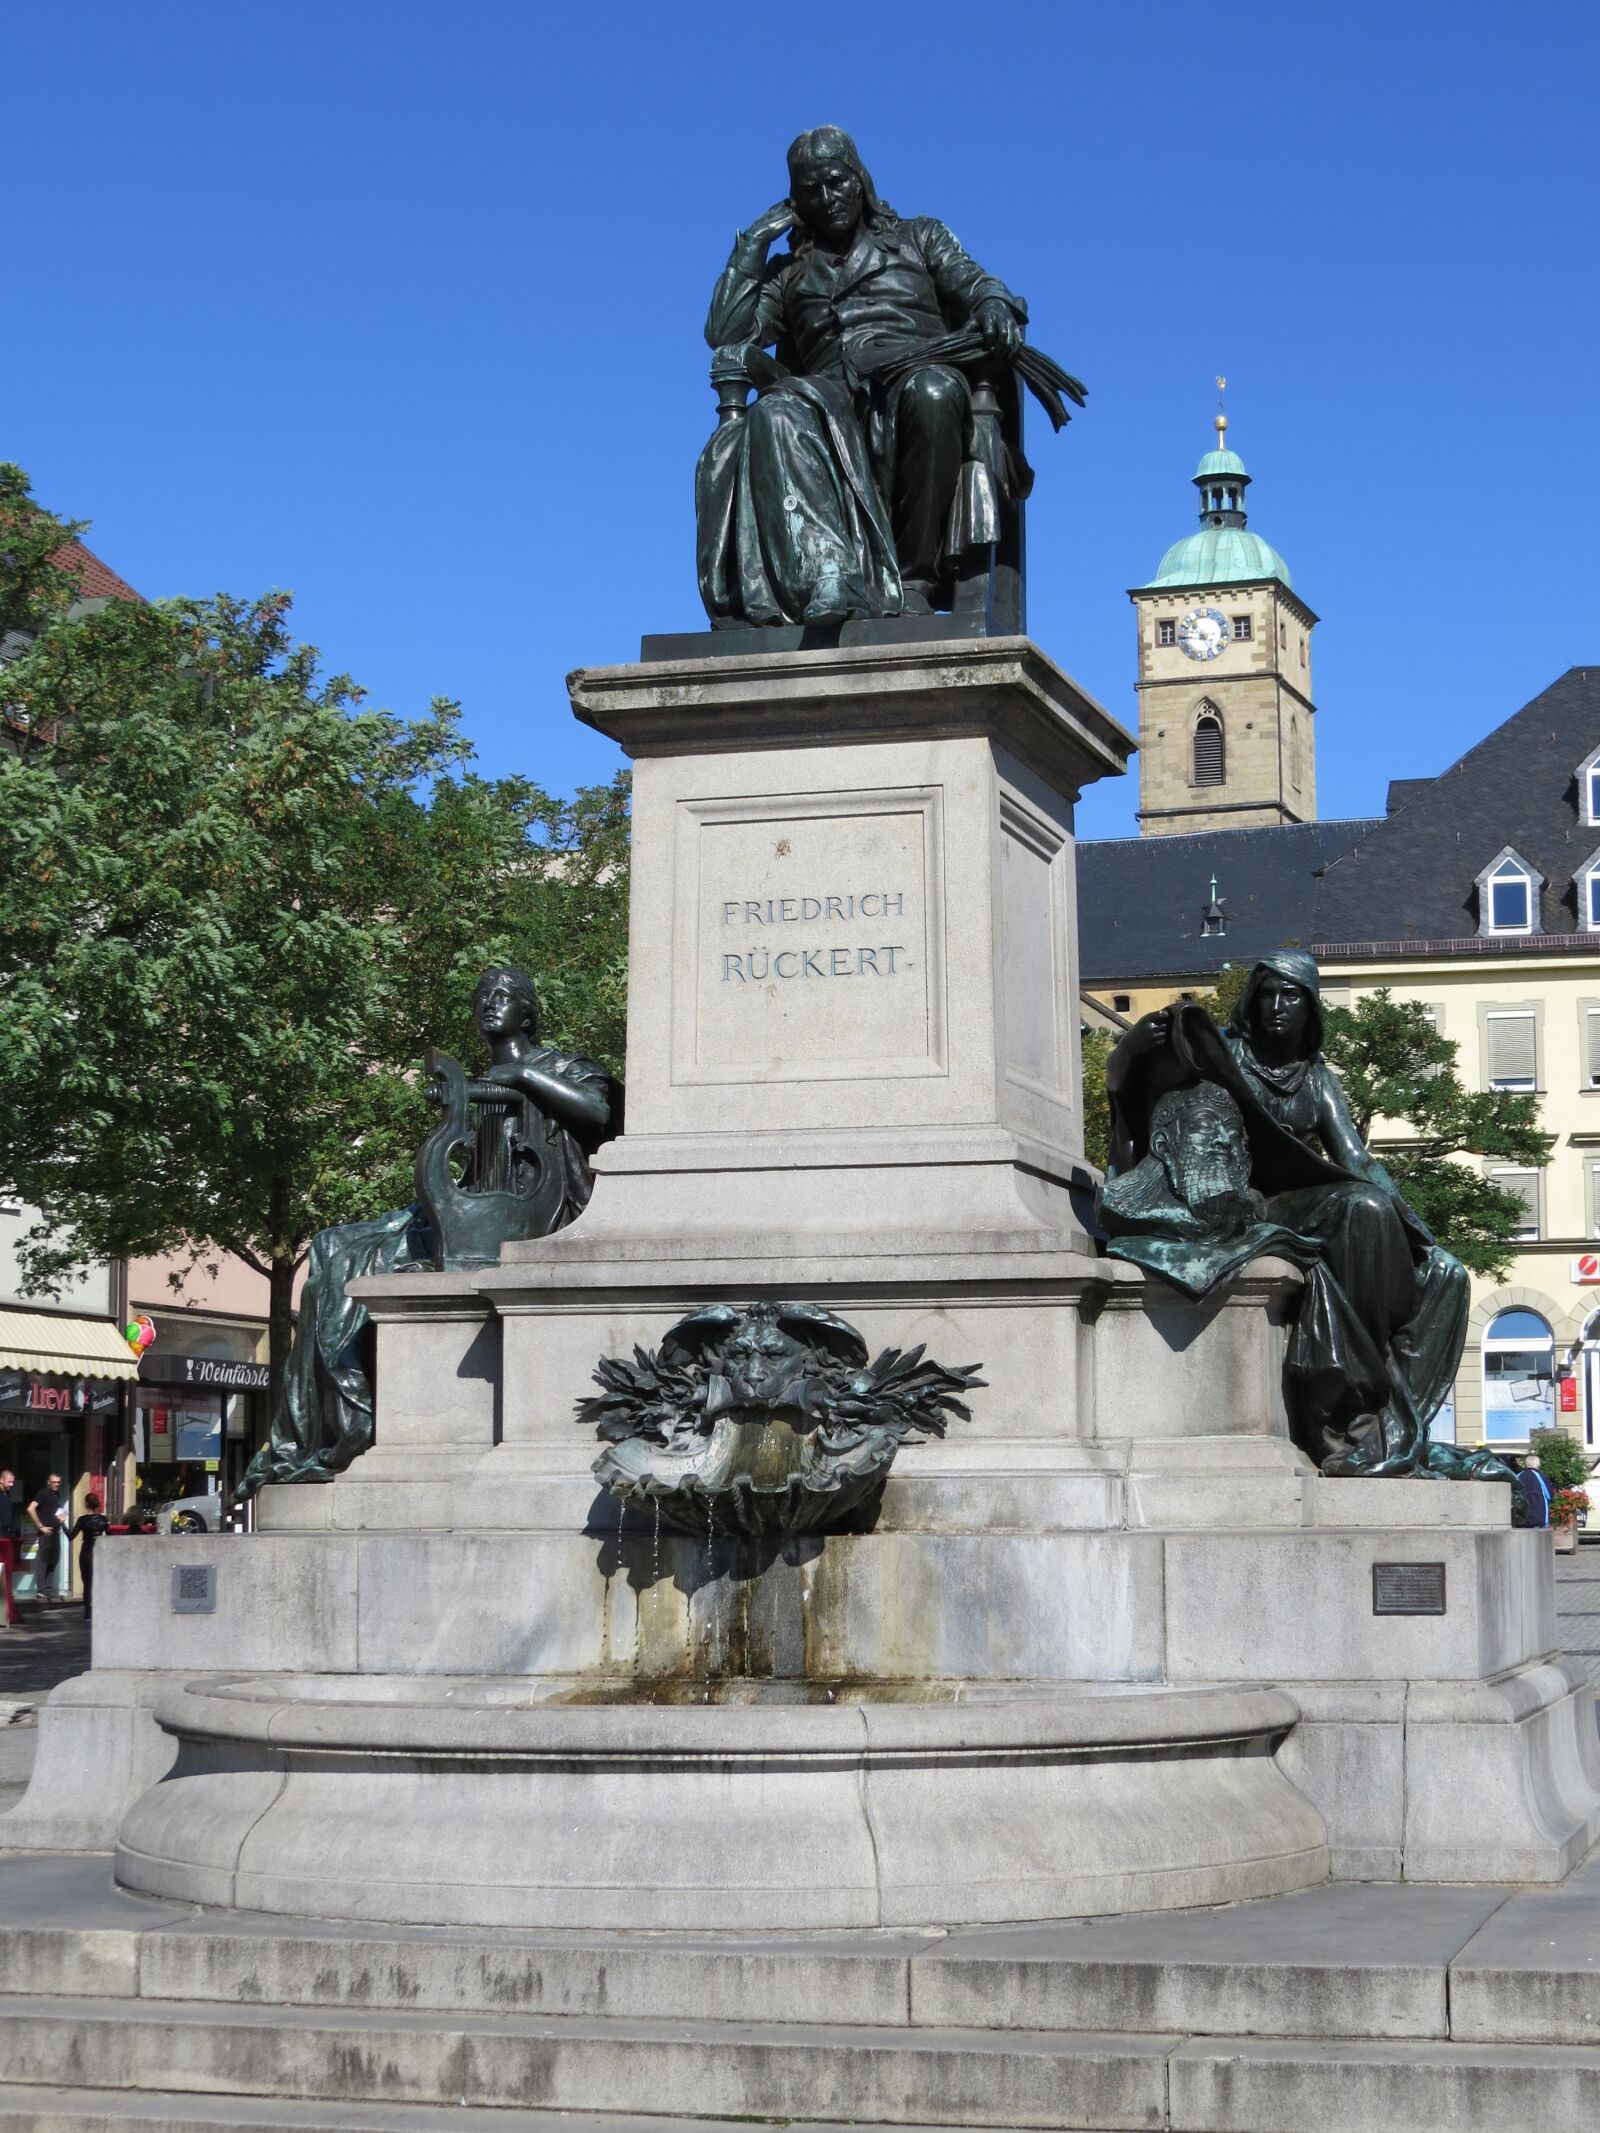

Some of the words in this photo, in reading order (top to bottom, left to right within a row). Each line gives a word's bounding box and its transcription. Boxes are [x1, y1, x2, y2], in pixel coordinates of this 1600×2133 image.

[722, 892, 904, 926] FRIEDRICH
[721, 946, 906, 983] RÜCKERT
[195, 1361, 270, 1387] Weinfässle
